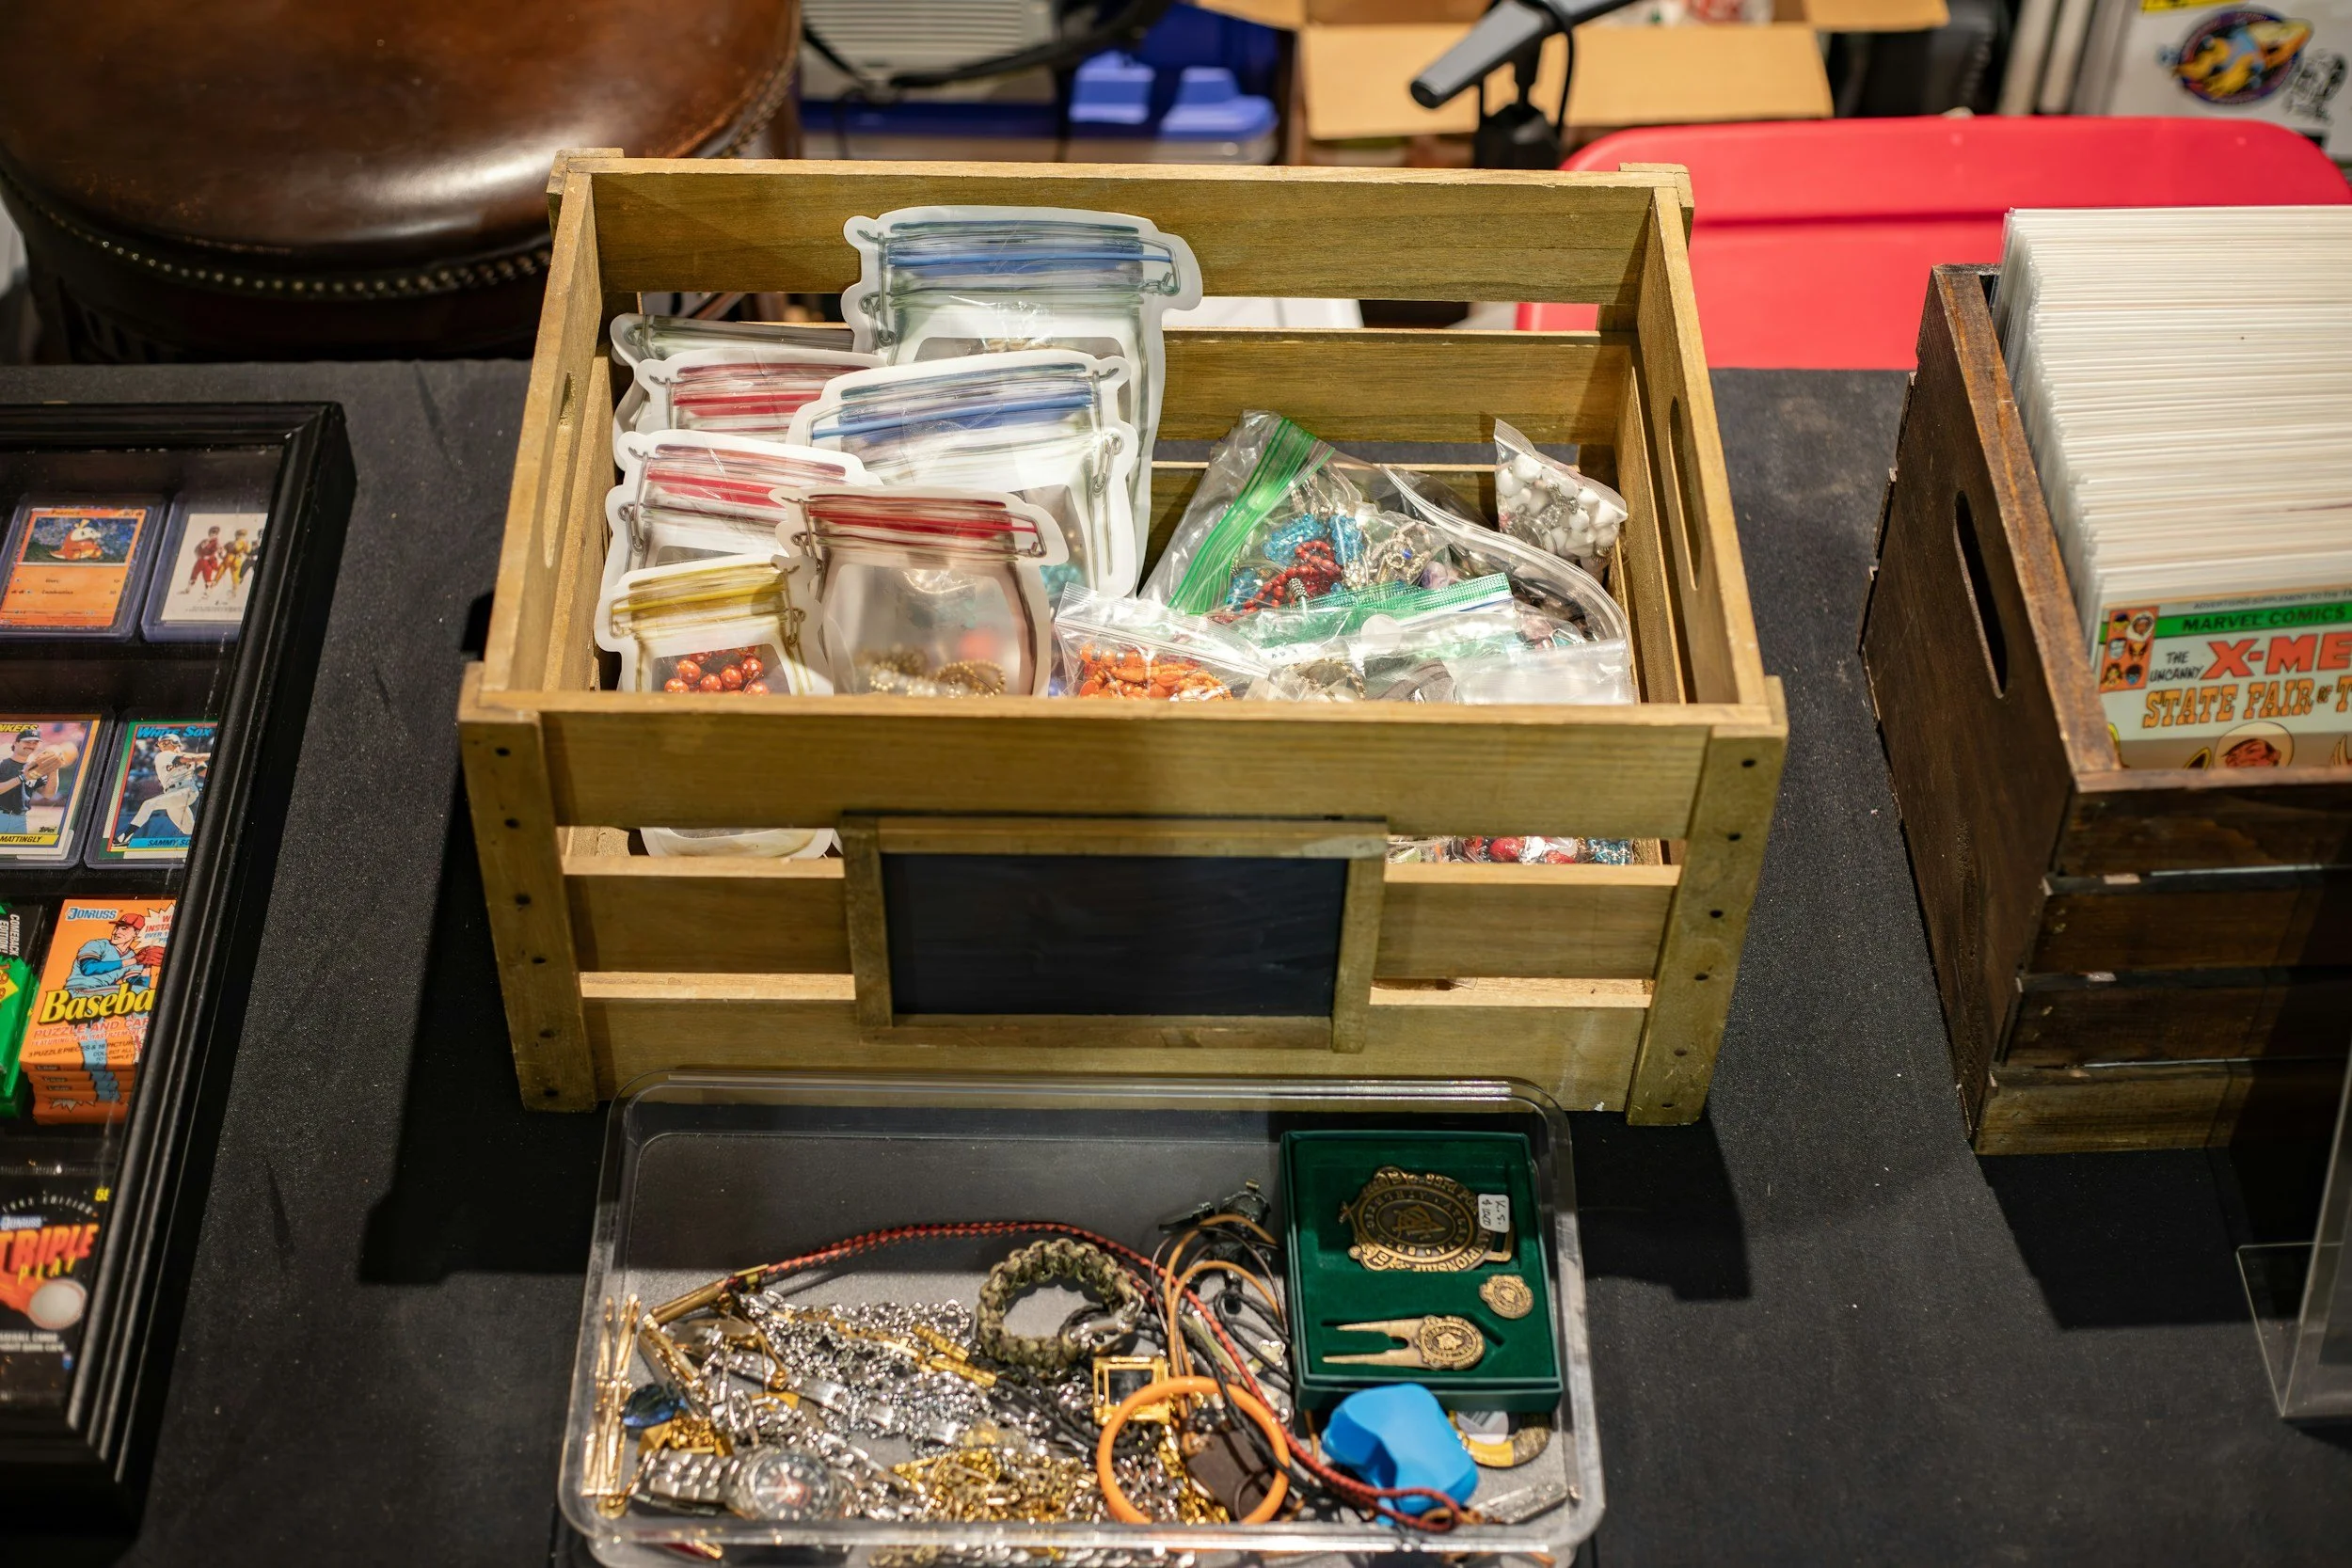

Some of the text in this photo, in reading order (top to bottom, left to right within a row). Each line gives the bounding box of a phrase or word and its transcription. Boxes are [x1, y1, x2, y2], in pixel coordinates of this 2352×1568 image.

[2183, 605, 2345, 631] MARVEL COMICS
[2166, 651, 2189, 664] THE
[2199, 631, 2352, 681] X-ME
[2149, 665, 2204, 683] UNCANNY
[2142, 684, 2239, 729] STATE
[2242, 678, 2315, 720] FAIR
[0, 920, 8, 954] EDITION!
[9, 913, 20, 957] COMEBACK
[34, 1023, 88, 1038] PUZZLE
[90, 1021, 119, 1032] AND
[62, 1045, 89, 1053] PIECES
[0, 1224, 100, 1273] TRIPLE
[18, 1256, 76, 1286] PLAY
